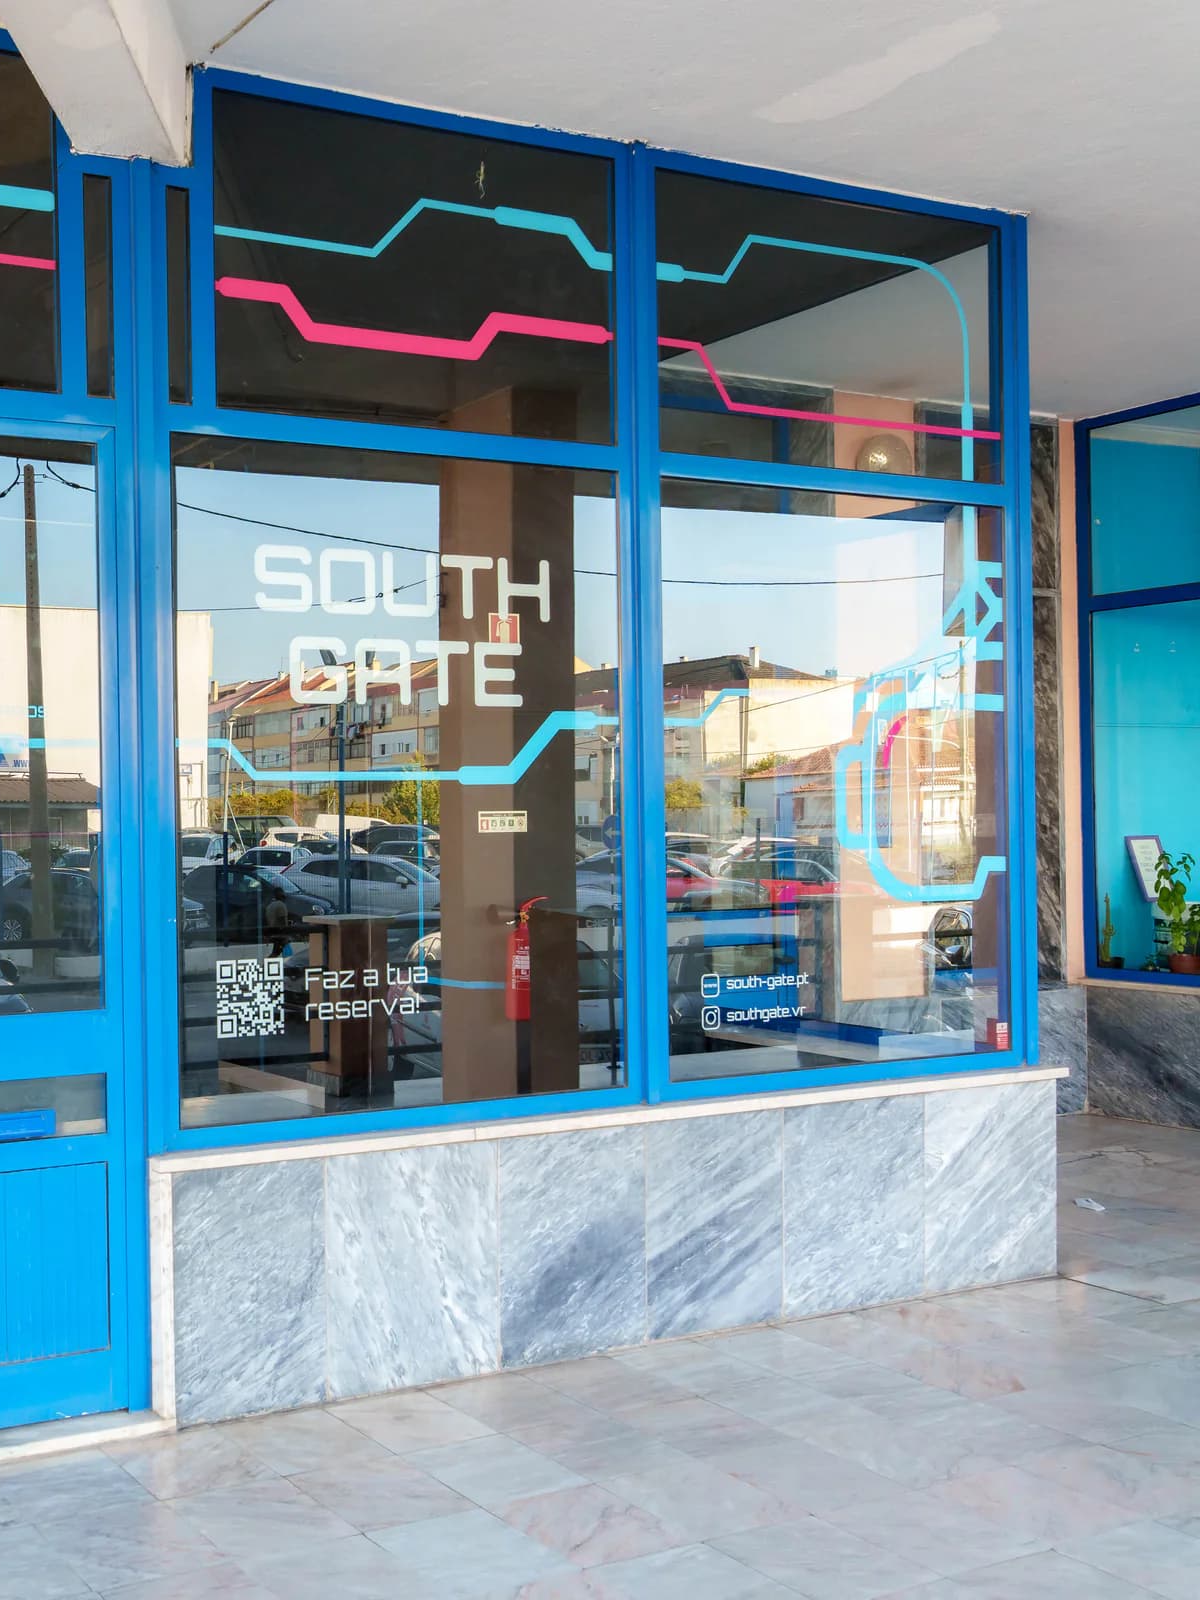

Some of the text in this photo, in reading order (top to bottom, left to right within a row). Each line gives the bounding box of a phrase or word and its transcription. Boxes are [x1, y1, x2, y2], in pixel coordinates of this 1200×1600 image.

[253, 543, 550, 623] SOUTH
[289, 636, 523, 708] GATE
[305, 962, 429, 991] Faz a tua
[726, 972, 809, 991] south-gate.pt
[305, 996, 420, 1022] reserva!
[726, 1005, 807, 1022] southgate.vr
